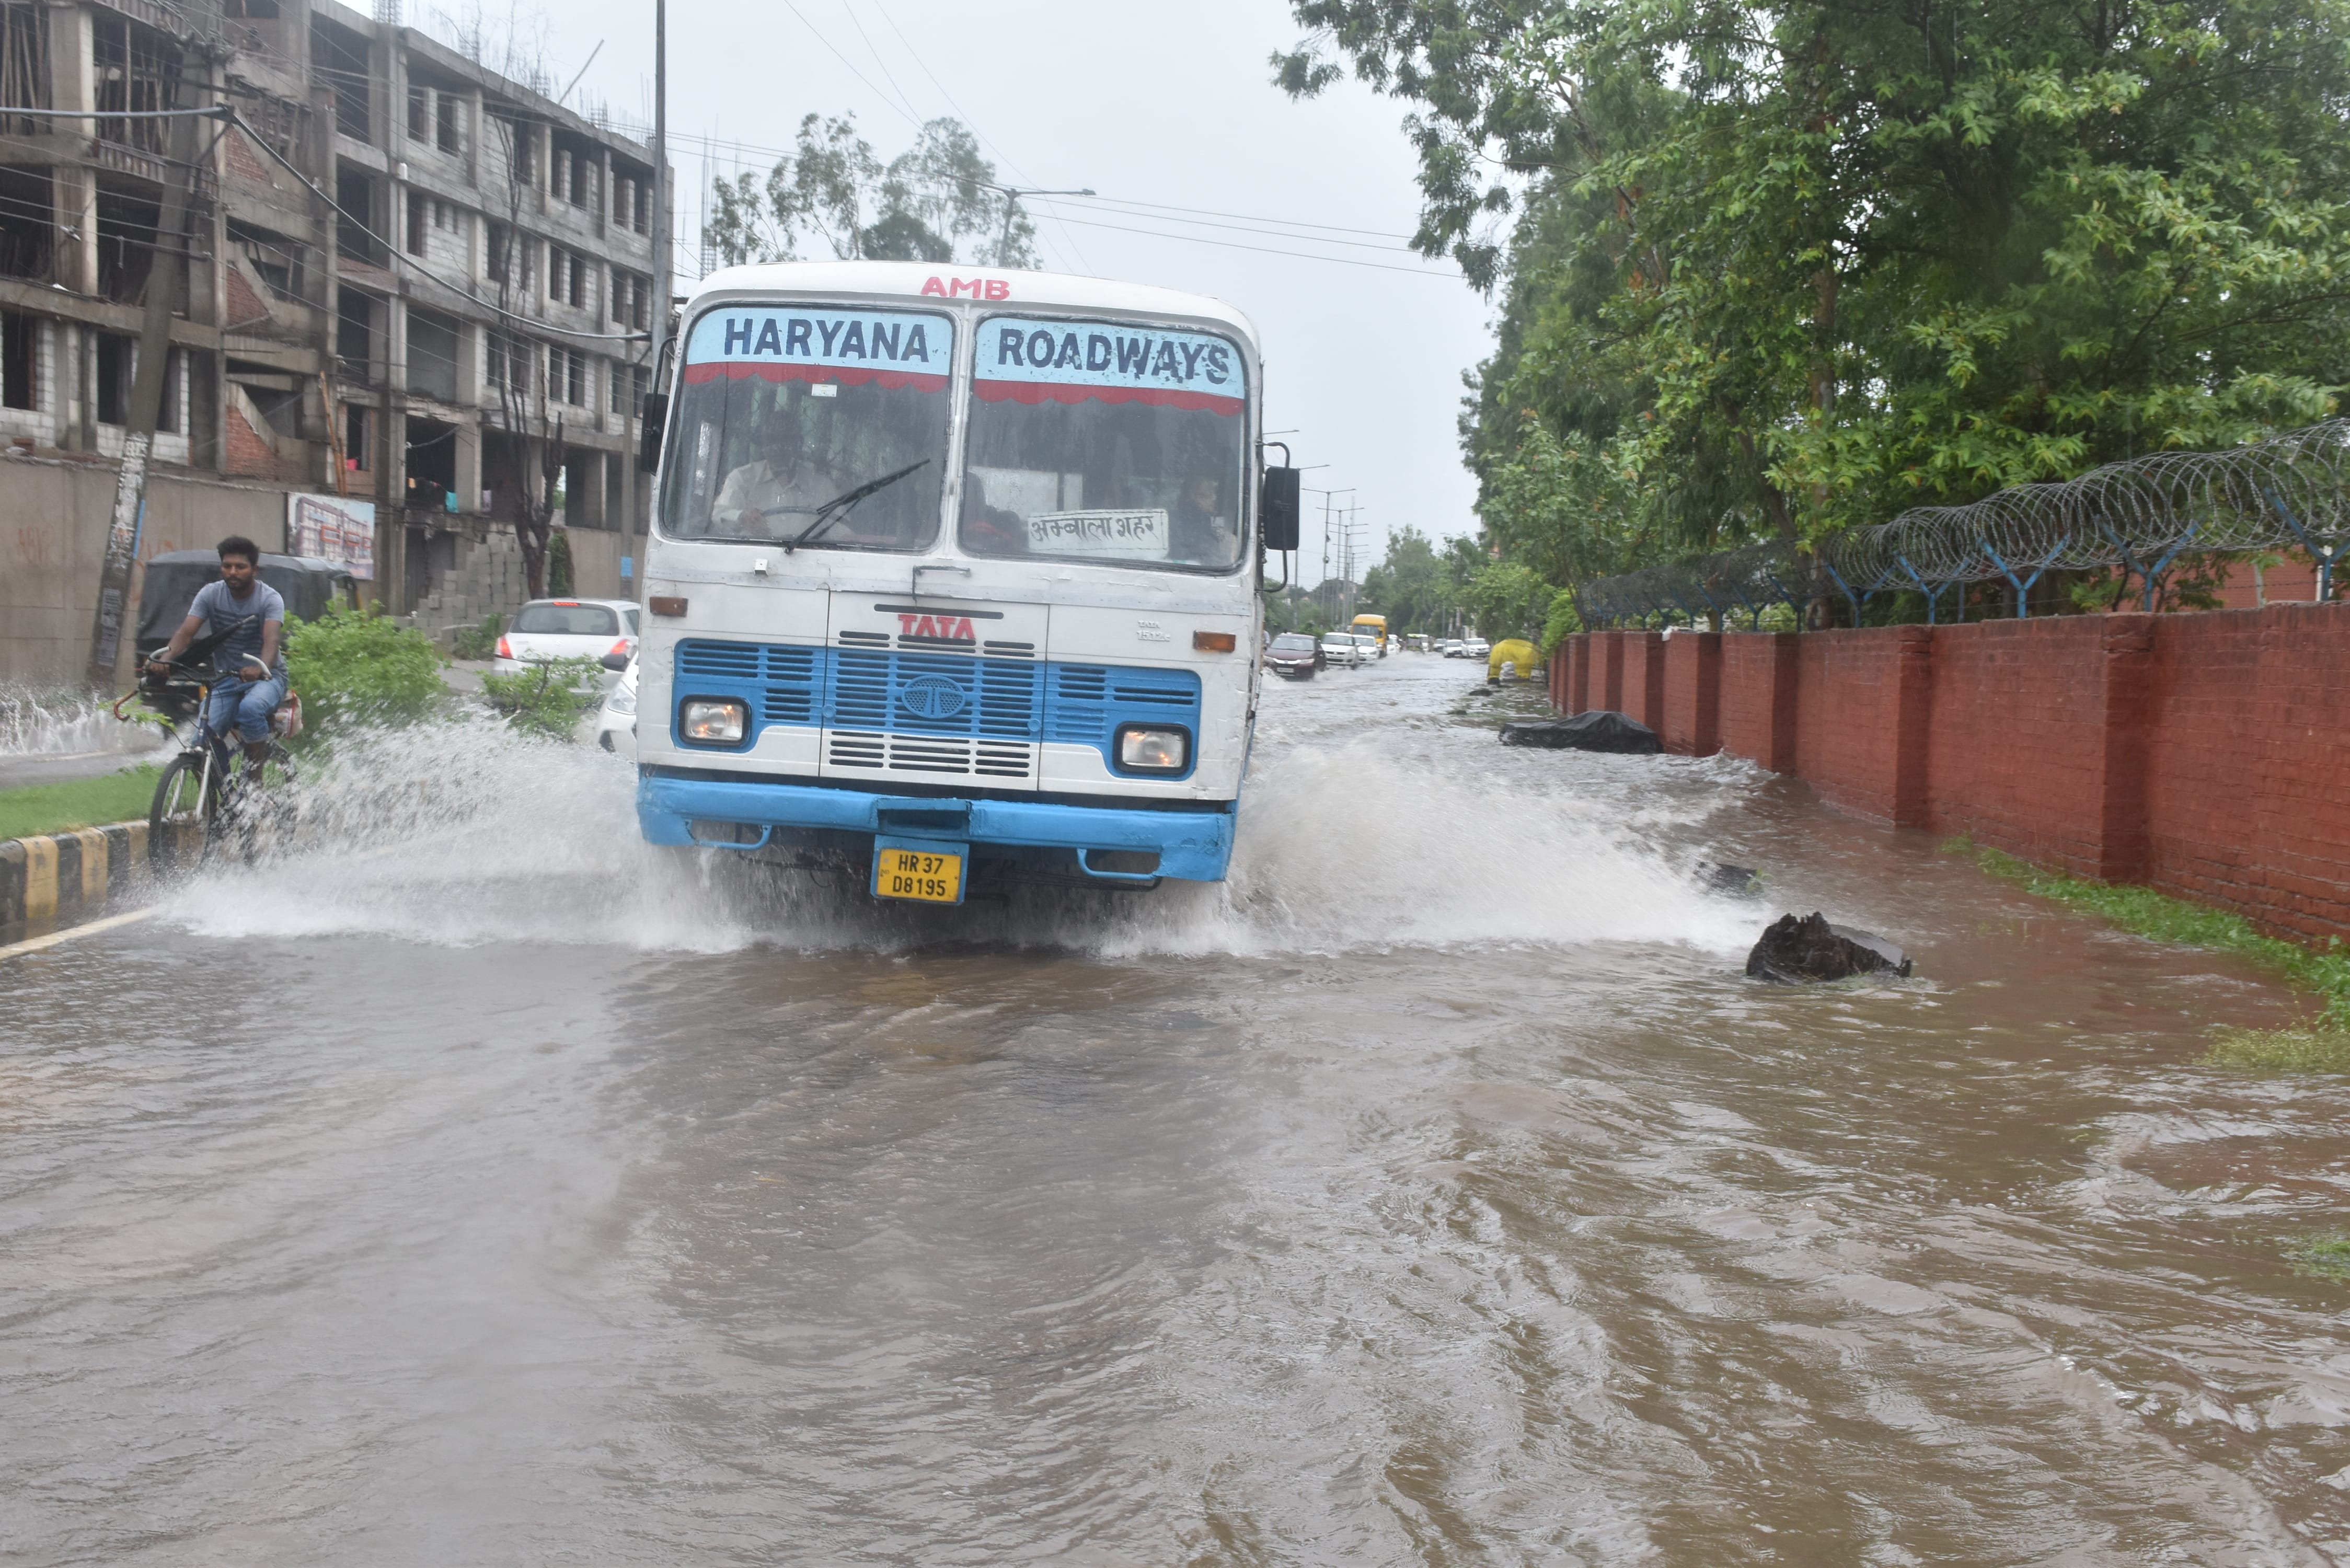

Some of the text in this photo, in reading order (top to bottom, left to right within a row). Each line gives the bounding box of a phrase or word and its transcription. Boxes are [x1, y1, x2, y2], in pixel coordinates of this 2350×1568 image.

[920, 276, 1010, 301] AMB
[724, 318, 1230, 385] HARYANA ROADWAYS
[1031, 516, 1158, 541] अम्बाला शहर
[898, 614, 975, 640] TATA
[1138, 620, 1160, 629] TATA
[898, 854, 943, 874] HR 37
[892, 875, 946, 896] D8195
